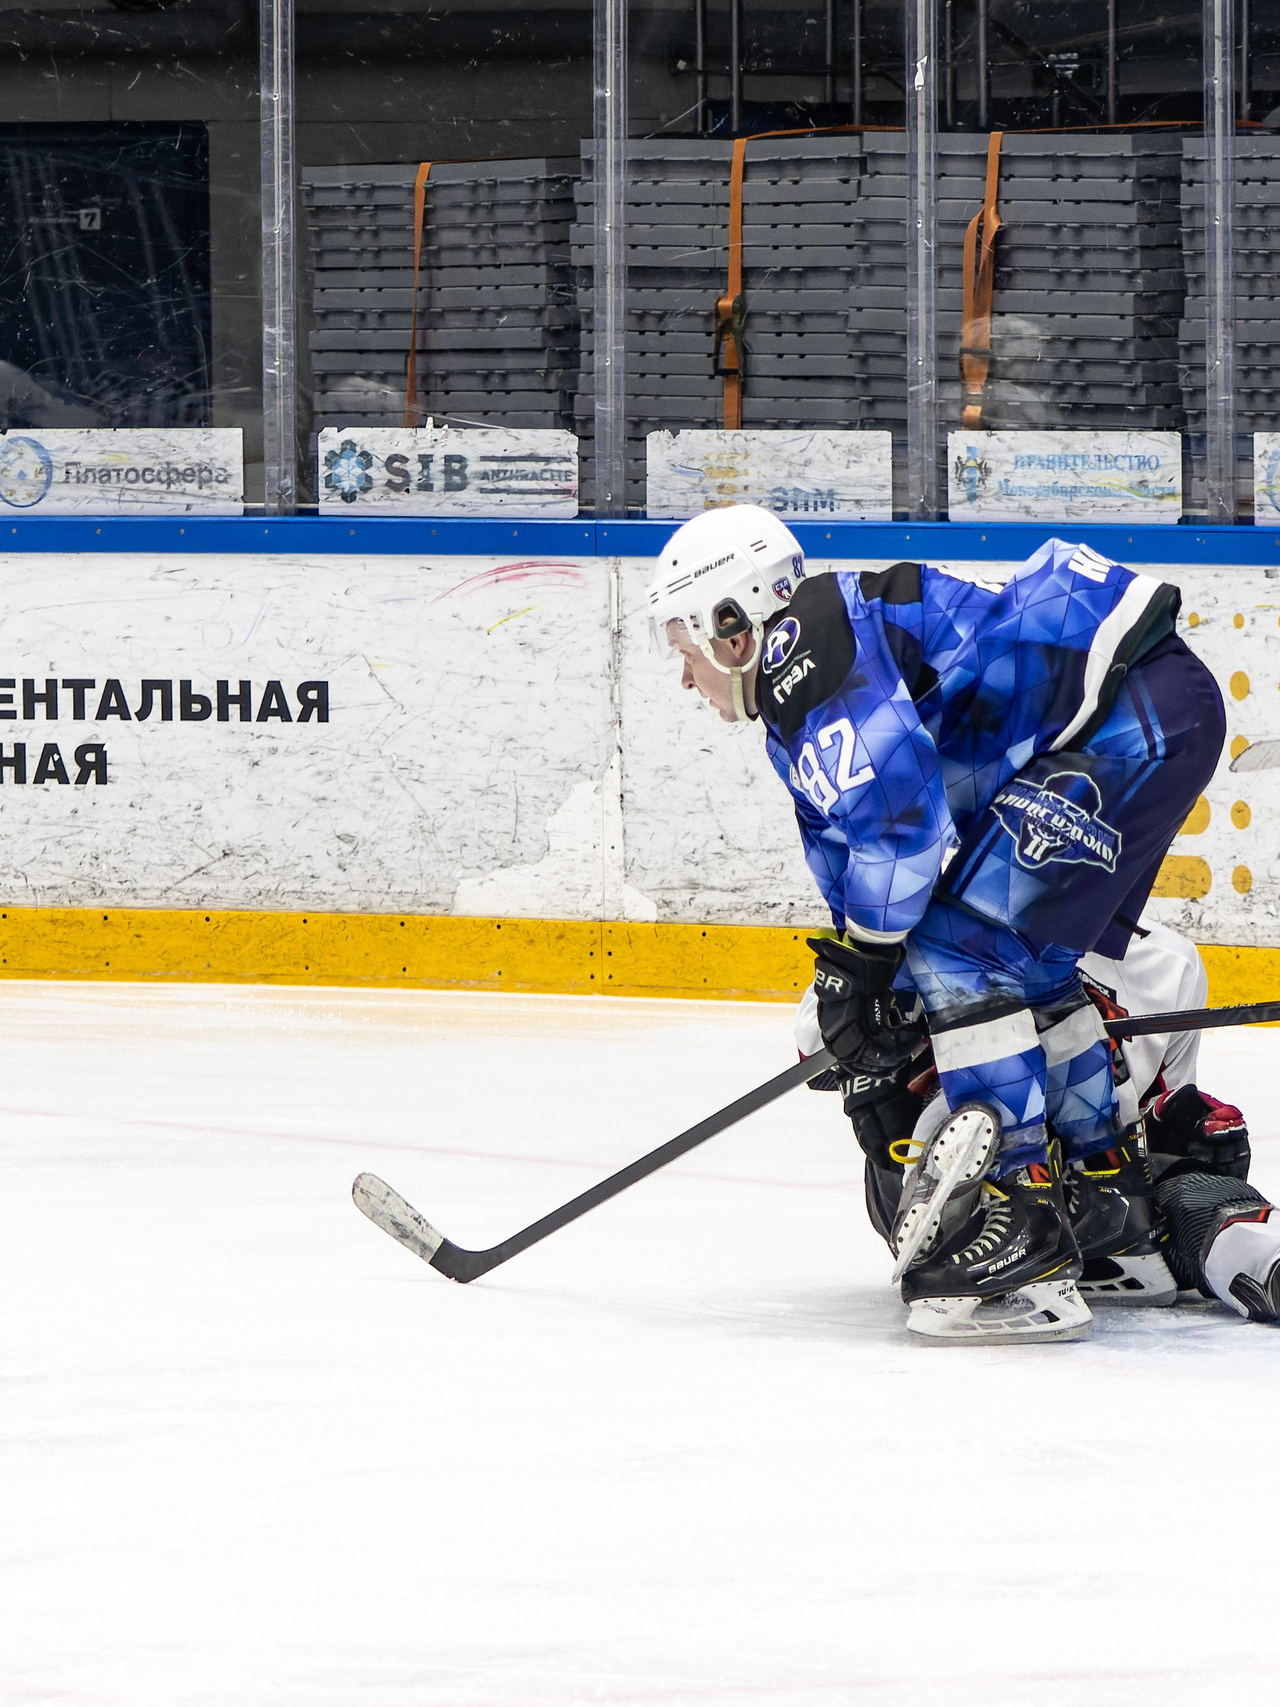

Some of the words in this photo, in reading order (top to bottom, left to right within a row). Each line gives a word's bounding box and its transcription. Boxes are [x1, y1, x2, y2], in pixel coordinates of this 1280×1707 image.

[85, 212, 97, 228] 7
[64, 461, 233, 490] Платосфера
[385, 453, 468, 493] SIB
[693, 553, 735, 578] BAUER
[0, 742, 108, 785] НАЯ
[798, 717, 876, 816] 82
[988, 1248, 1027, 1274] BAUER
